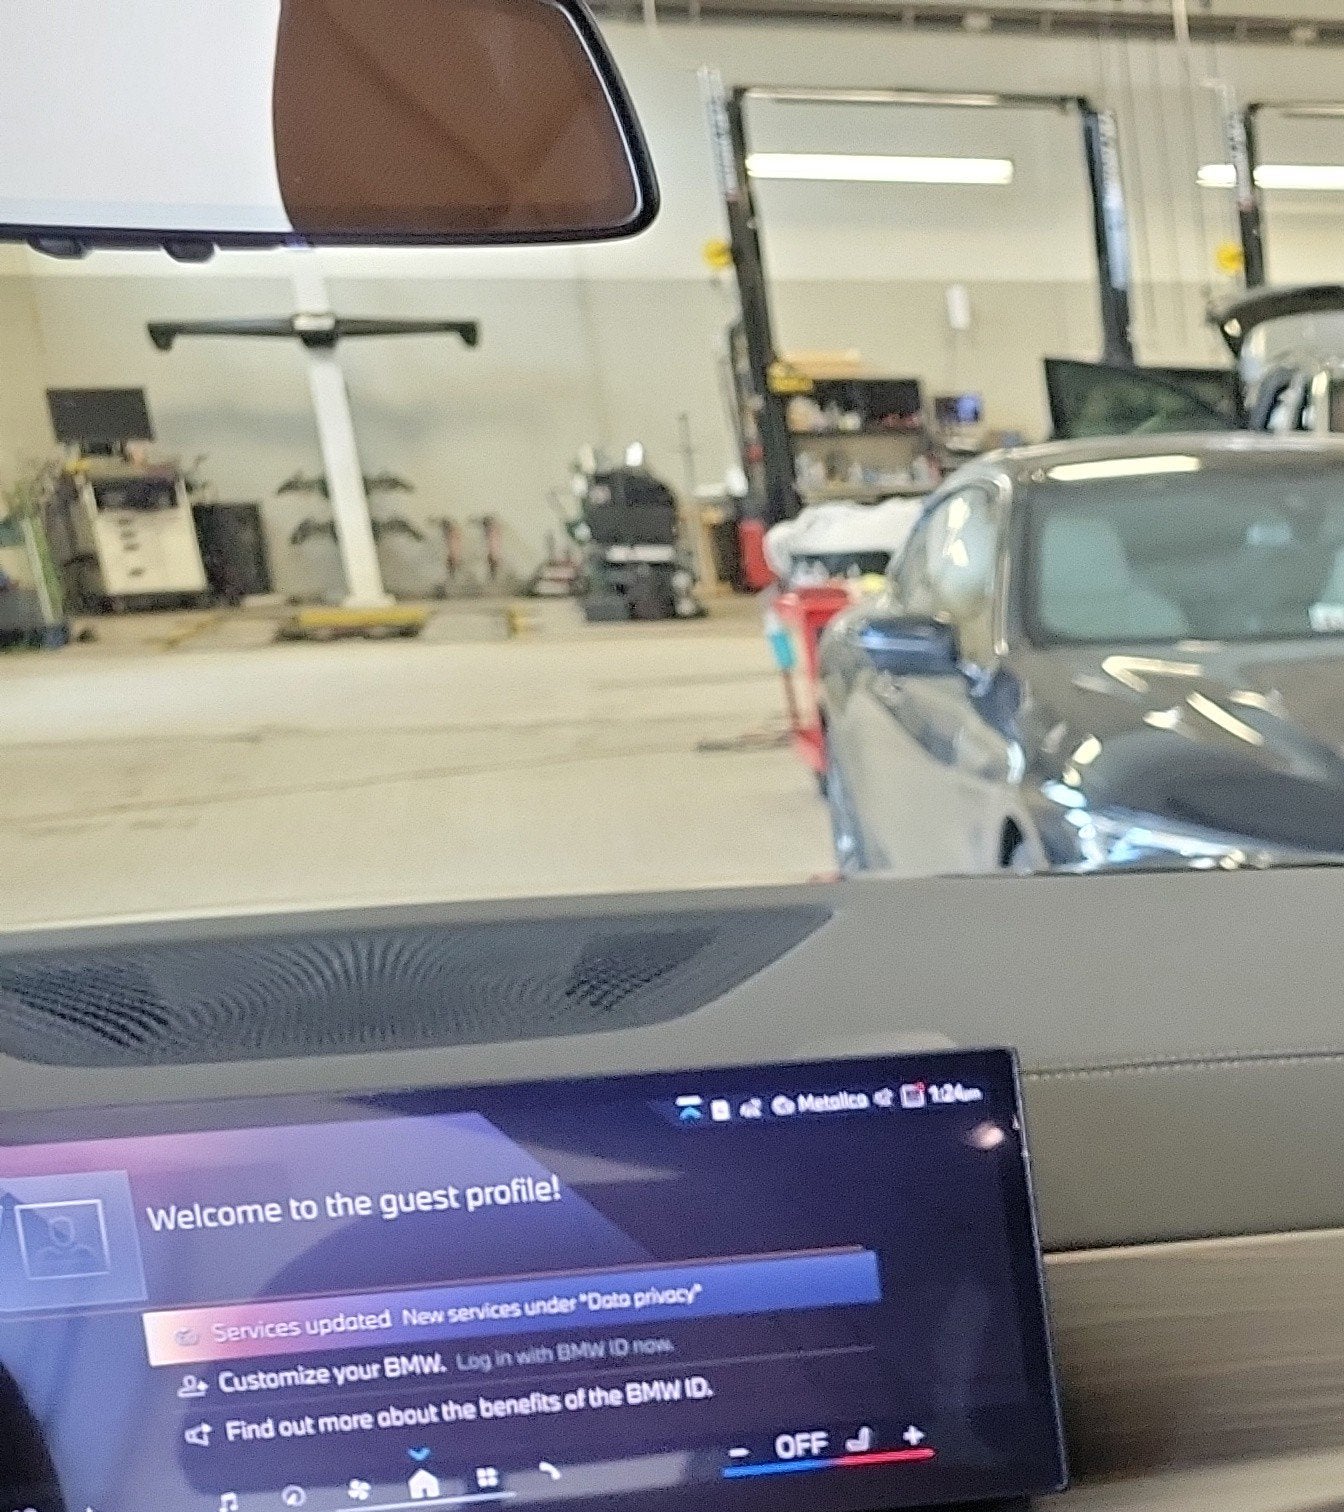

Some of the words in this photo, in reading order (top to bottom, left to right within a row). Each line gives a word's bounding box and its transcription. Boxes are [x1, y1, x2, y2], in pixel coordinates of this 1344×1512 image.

[146, 1203, 282, 1232] Welcome
[289, 1198, 318, 1221] to
[325, 1192, 372, 1218] the
[380, 1186, 461, 1220] guest
[465, 1173, 561, 1212] profile!
[212, 1320, 301, 1343] Services
[305, 1309, 393, 1337] updated
[402, 1308, 445, 1326] New
[448, 1302, 521, 1323] services
[524, 1295, 576, 1316] under
[578, 1291, 631, 1312] "Data
[633, 1283, 702, 1309] privacy"
[218, 1364, 331, 1393] Customize
[332, 1362, 381, 1386] your
[383, 1351, 448, 1379] BMW.
[455, 1352, 492, 1373] Log
[495, 1350, 513, 1366] in
[516, 1346, 554, 1365] with
[556, 1340, 605, 1361] BMW
[608, 1338, 628, 1356] ID
[633, 1338, 675, 1354] now.
[225, 1417, 275, 1442] Find
[278, 1415, 316, 1437] out
[318, 1411, 374, 1433] more
[377, 1403, 440, 1428] about
[441, 1400, 476, 1422] the
[479, 1391, 562, 1418] benefits
[564, 1387, 586, 1410] of
[588, 1386, 623, 1408] the
[625, 1379, 681, 1405] BMW
[685, 1376, 714, 1398] ID.
[775, 1431, 829, 1459] OFF
